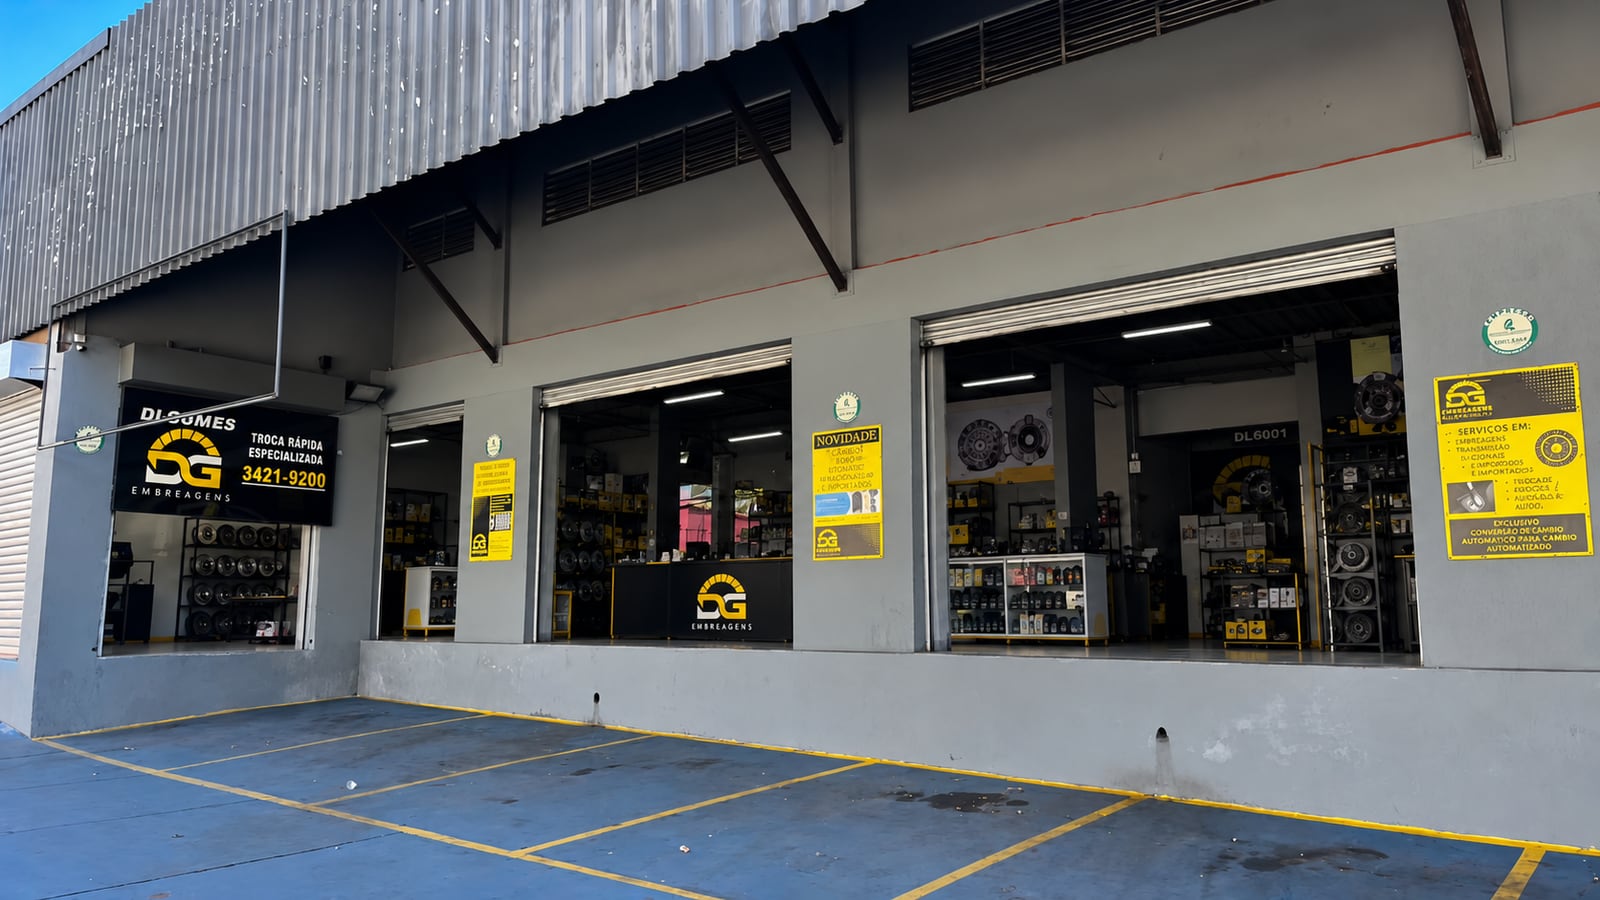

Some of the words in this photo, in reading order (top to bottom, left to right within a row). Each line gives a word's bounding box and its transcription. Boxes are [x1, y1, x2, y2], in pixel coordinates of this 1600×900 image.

[1512, 422, 1531, 431] EM:
[251, 433, 285, 447] TROCA
[288, 435, 323, 451] RÁPIDA
[817, 430, 877, 447] NOVIDADE
[1234, 428, 1287, 442] DL6001
[248, 448, 324, 465] ESPECIALIZADA
[242, 466, 326, 488] 3421-9200
[132, 486, 231, 502] EMBREAGENS
[691, 623, 752, 631] EMBREAGENS
